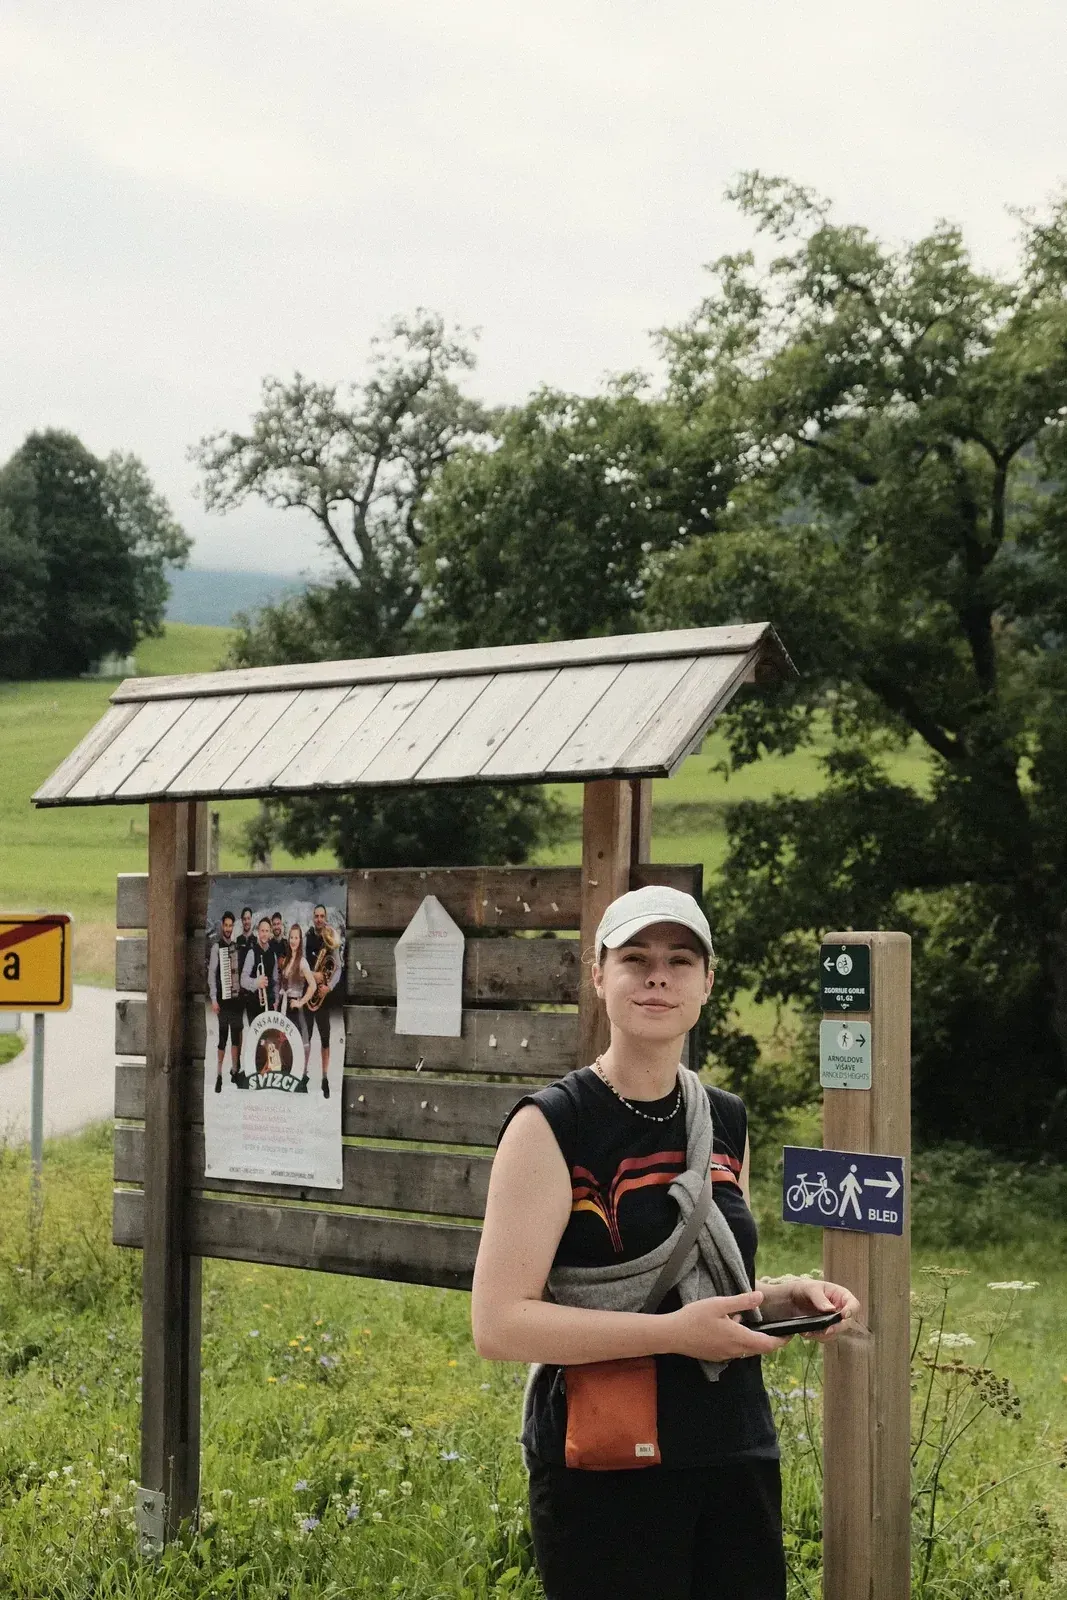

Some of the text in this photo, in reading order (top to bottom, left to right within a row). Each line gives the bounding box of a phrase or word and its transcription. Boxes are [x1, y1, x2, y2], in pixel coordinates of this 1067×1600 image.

[253, 1016, 294, 1037] ANSAMBEL
[828, 1056, 863, 1064] ARNOLDOVE
[835, 1063, 856, 1072] VIŠAVE
[848, 1072, 869, 1080] HEIGHTS
[868, 1208, 898, 1223] BLED
